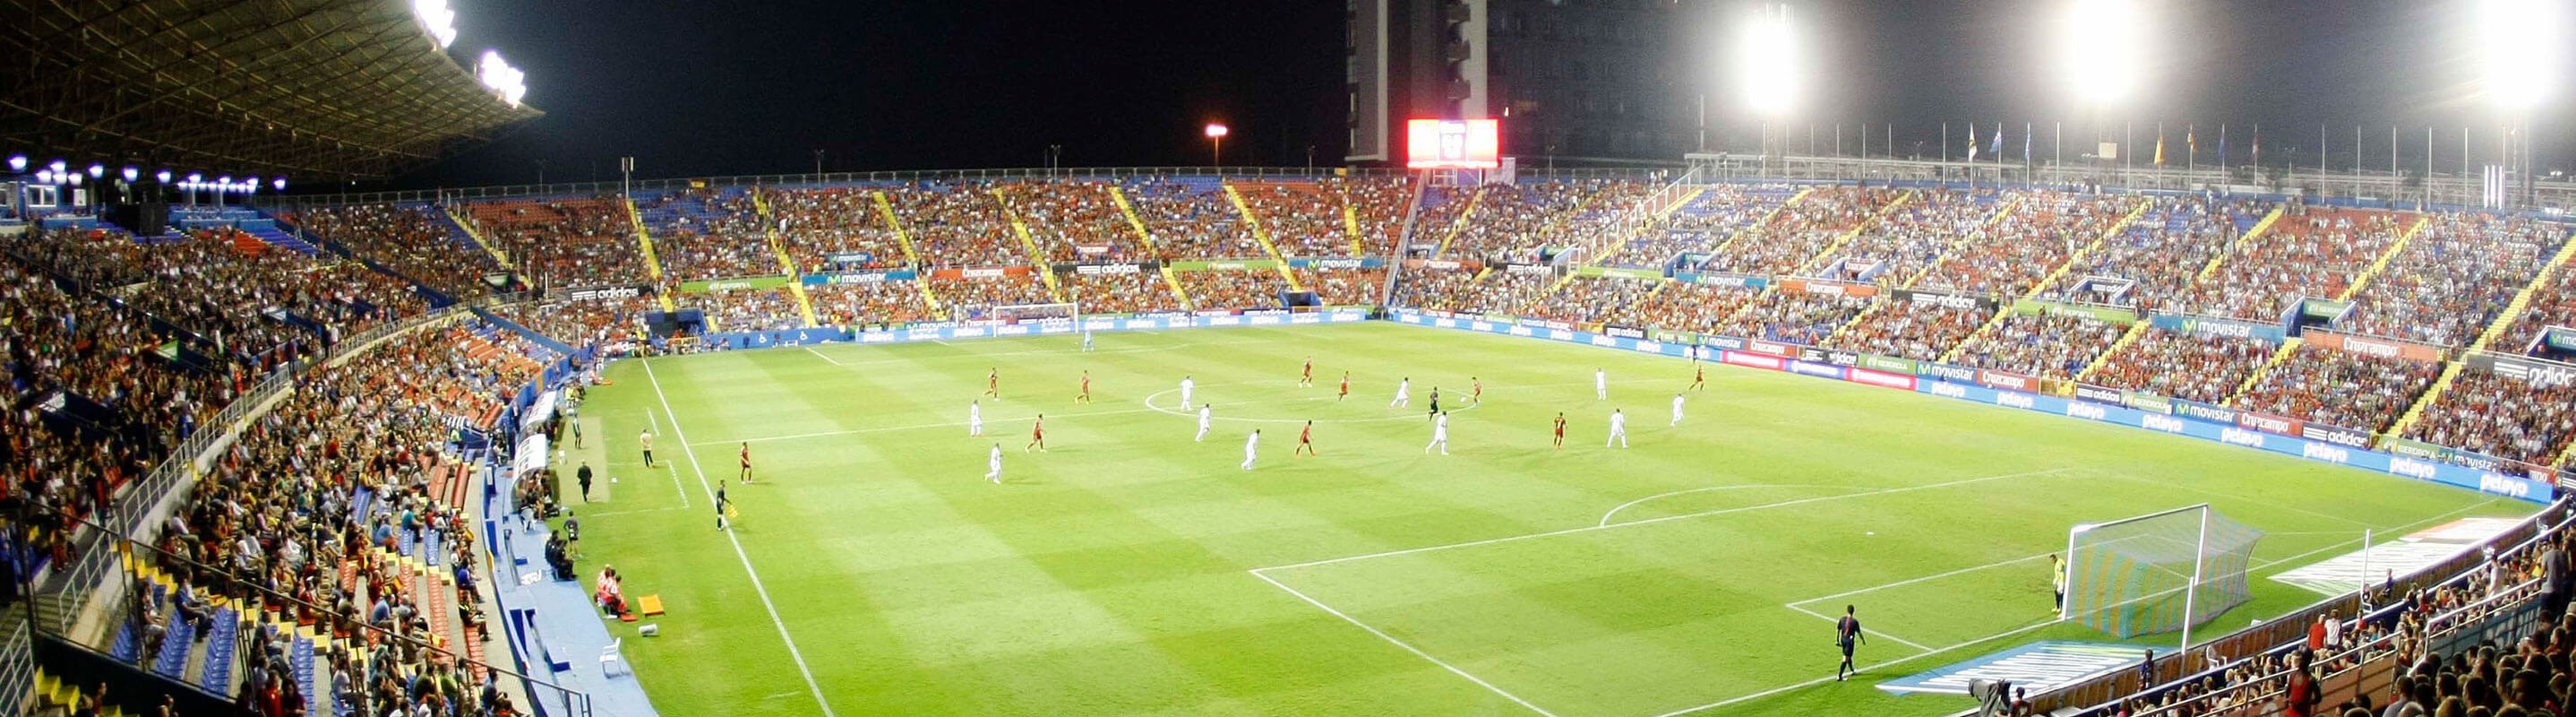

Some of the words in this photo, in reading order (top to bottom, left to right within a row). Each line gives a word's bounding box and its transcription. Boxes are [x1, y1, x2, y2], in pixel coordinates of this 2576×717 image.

[1102, 263, 1139, 274] adidas
[1321, 258, 1362, 268] movistar
[842, 272, 887, 284] movistar
[1707, 275, 1746, 287] movistar
[597, 286, 639, 298] adidas
[2198, 319, 2252, 338] movistar
[1708, 336, 1741, 349] movistar
[2343, 336, 2399, 358] Cruzcampo
[1931, 365, 1974, 381] movistar
[1982, 370, 2025, 389] Cruzcampo
[1996, 392, 2033, 408] pelayo
[2093, 388, 2120, 402] adidas
[2066, 402, 2105, 420] pelayo
[2189, 404, 2235, 422] movistar
[2142, 414, 2183, 432] pelayo
[2241, 412, 2288, 433] Cruzcampo
[2220, 427, 2263, 447] pelayo
[2303, 443, 2348, 463] pelayo
[2389, 456, 2436, 479] pelayo
[2479, 472, 2529, 497] pelayo
